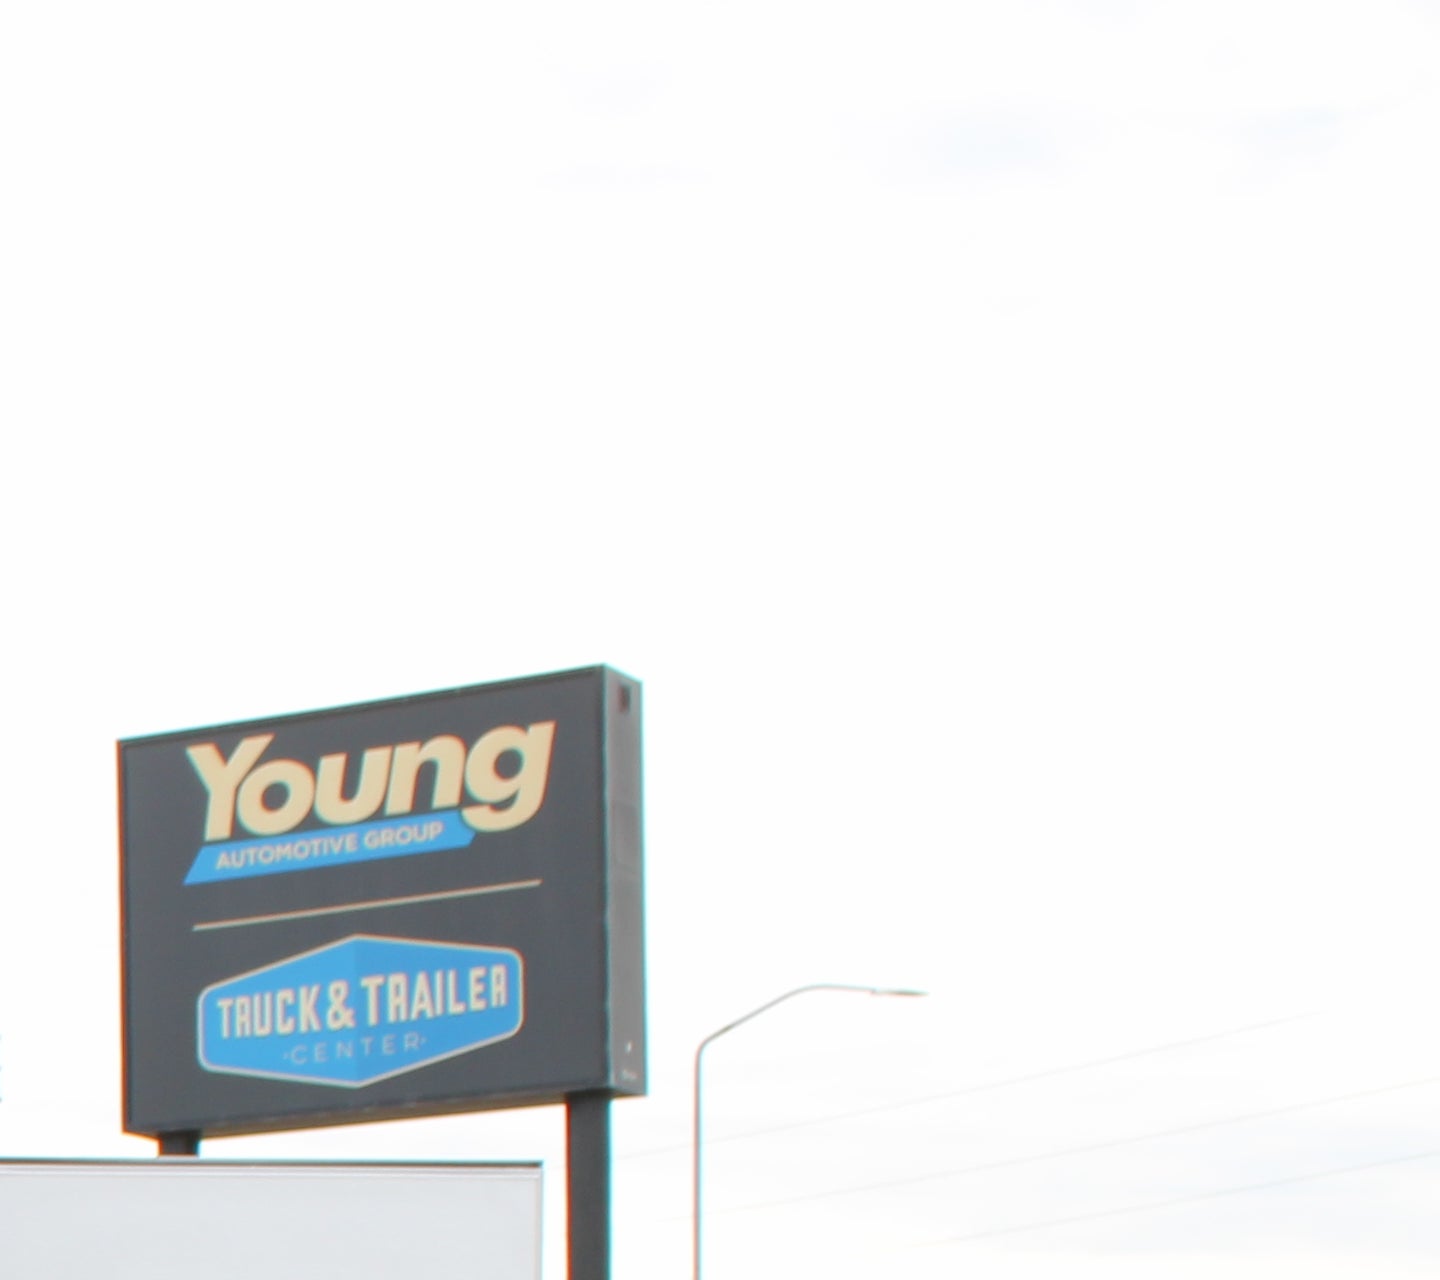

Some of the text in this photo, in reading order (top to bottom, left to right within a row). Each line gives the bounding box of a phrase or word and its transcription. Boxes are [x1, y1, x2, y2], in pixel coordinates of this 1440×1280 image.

[187, 720, 557, 842] Young
[216, 820, 444, 870] AUTOMOTIVE GROUP
[218, 964, 508, 1039] TRUCK & TRAILER
[290, 1031, 422, 1066] CENTER
